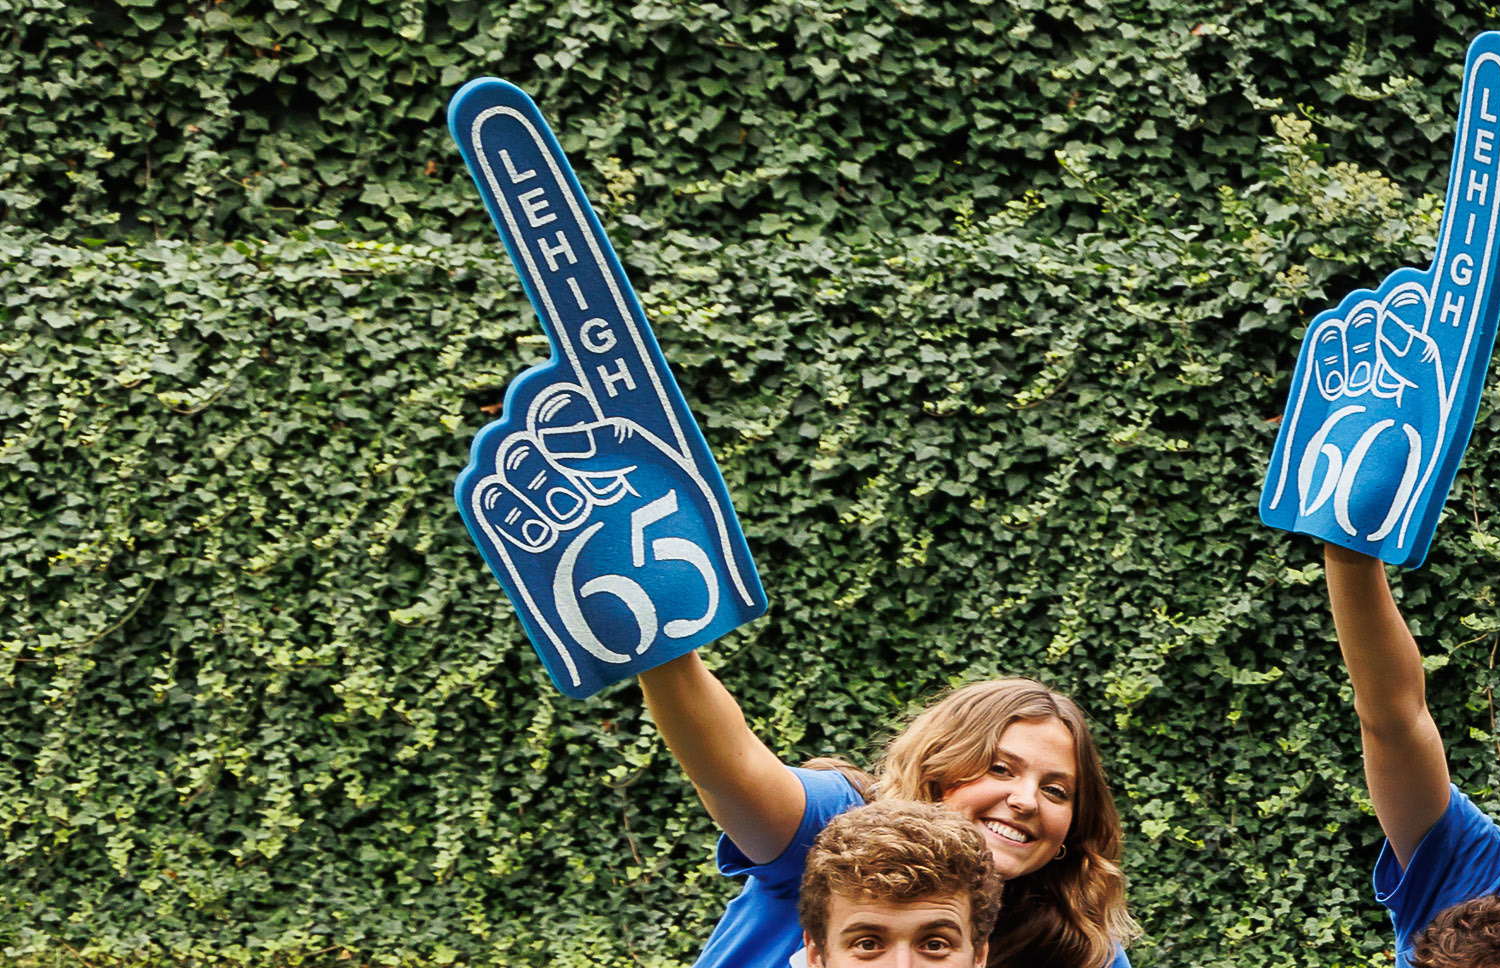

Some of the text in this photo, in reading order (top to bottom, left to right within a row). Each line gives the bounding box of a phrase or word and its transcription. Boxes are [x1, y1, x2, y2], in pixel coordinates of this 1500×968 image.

[498, 149, 636, 398] LEHIGH
[1440, 87, 1497, 328] LEHIGH
[553, 488, 719, 663] 65
[1298, 405, 1422, 542] 60
